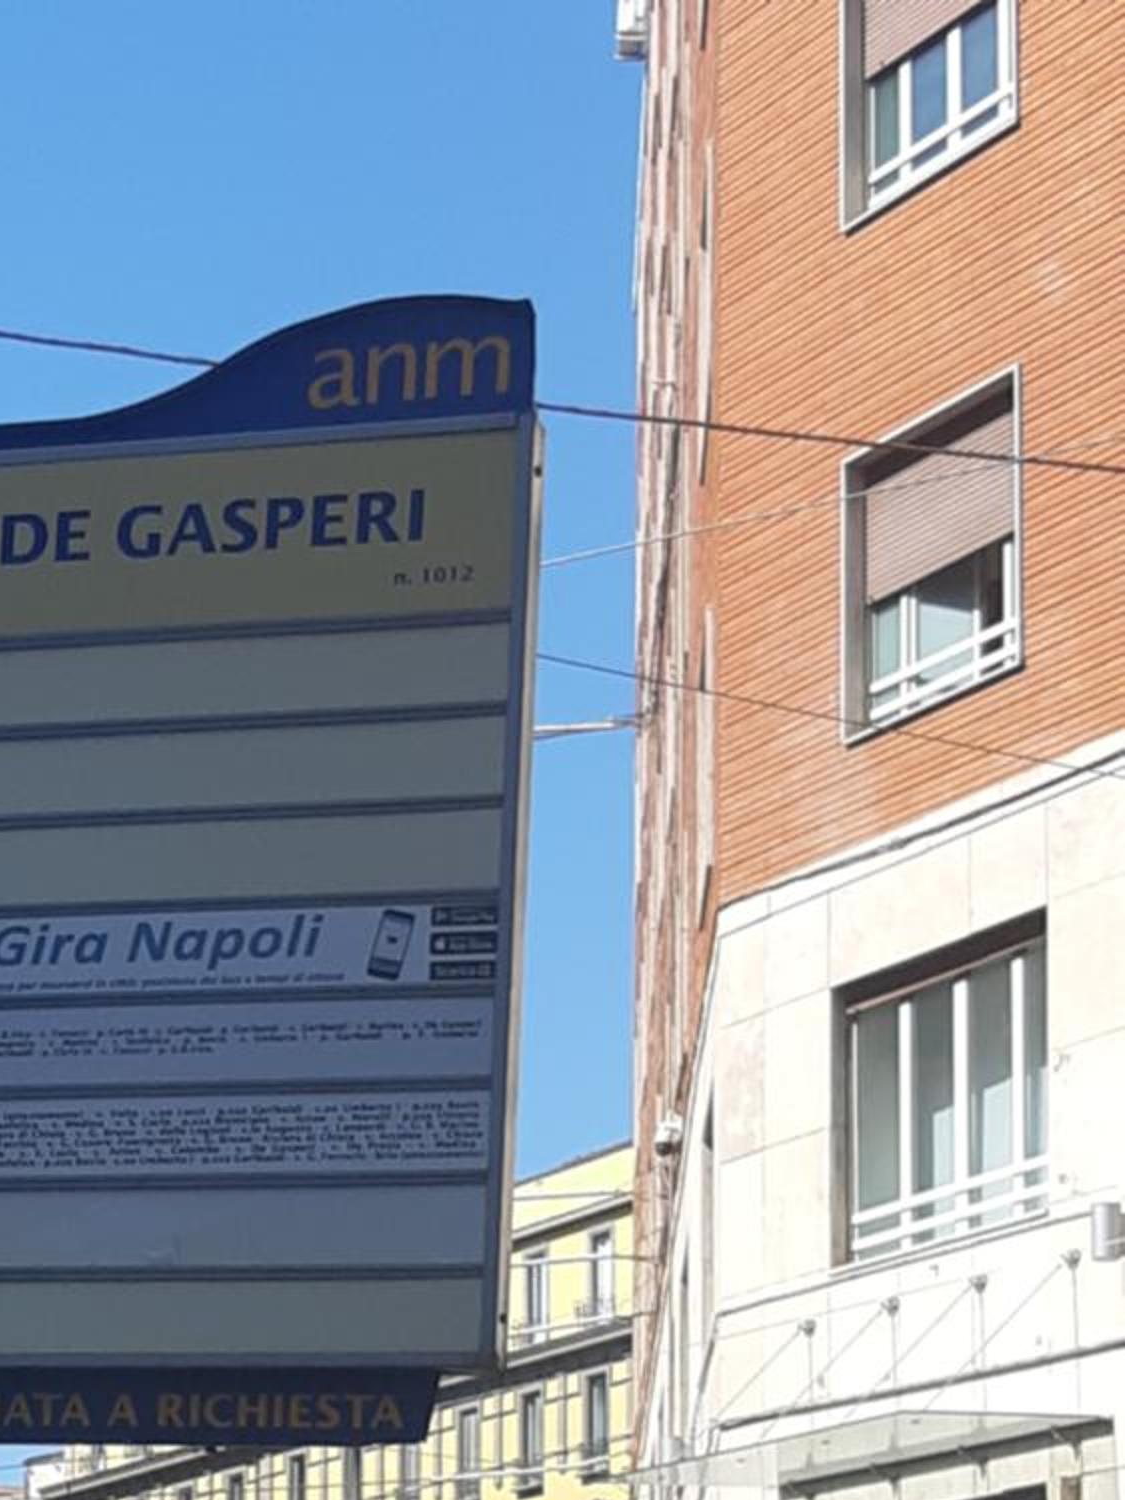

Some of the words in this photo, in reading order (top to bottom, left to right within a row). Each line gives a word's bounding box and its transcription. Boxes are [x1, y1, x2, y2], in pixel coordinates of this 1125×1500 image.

[309, 334, 511, 410] anm
[0, 509, 92, 567] DE
[117, 487, 427, 561] GASPERI
[422, 565, 474, 584] 1012
[127, 914, 325, 971] Napoli
[108, 1393, 139, 1429] A
[157, 1392, 405, 1430] RICHIESTA
